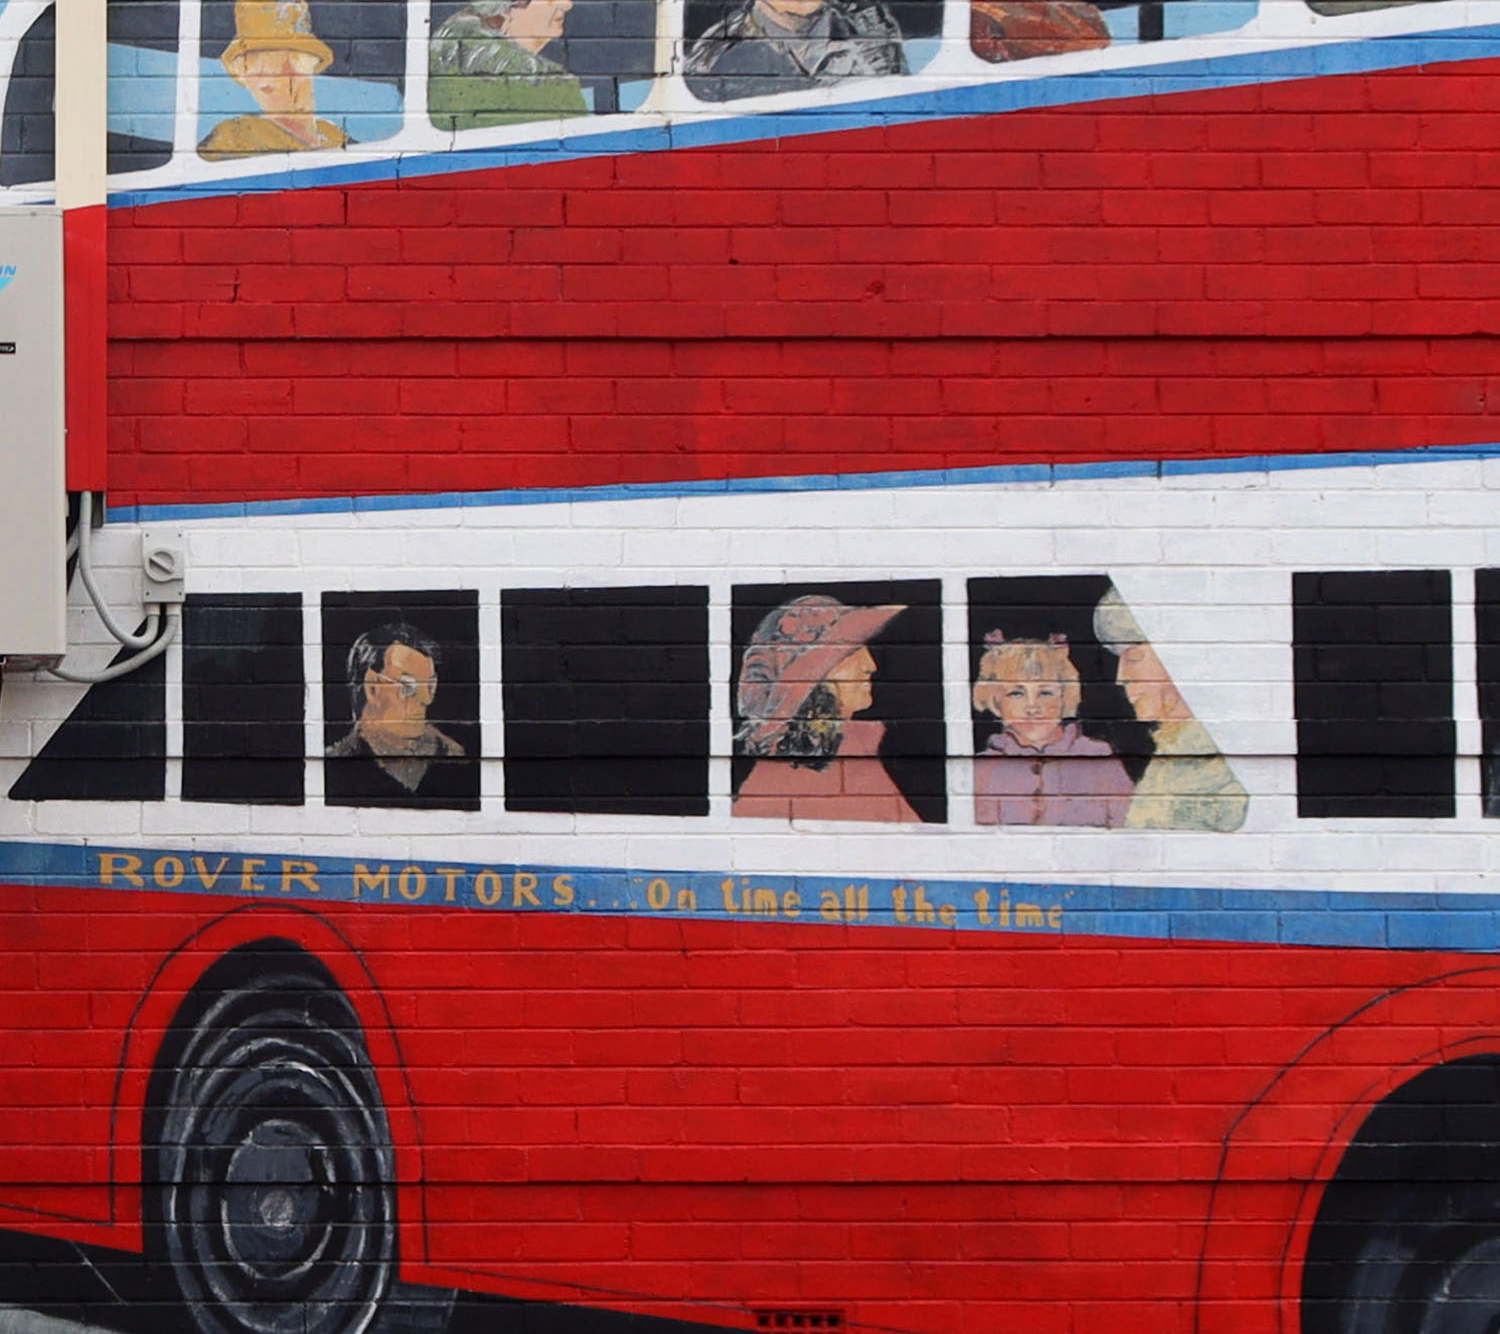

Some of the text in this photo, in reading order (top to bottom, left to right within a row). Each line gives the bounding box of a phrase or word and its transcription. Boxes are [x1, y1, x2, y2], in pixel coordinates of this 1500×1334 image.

[96, 852, 321, 892] ROVER
[721, 877, 801, 917] time
[819, 884, 870, 923] all
[890, 884, 958, 926] the
